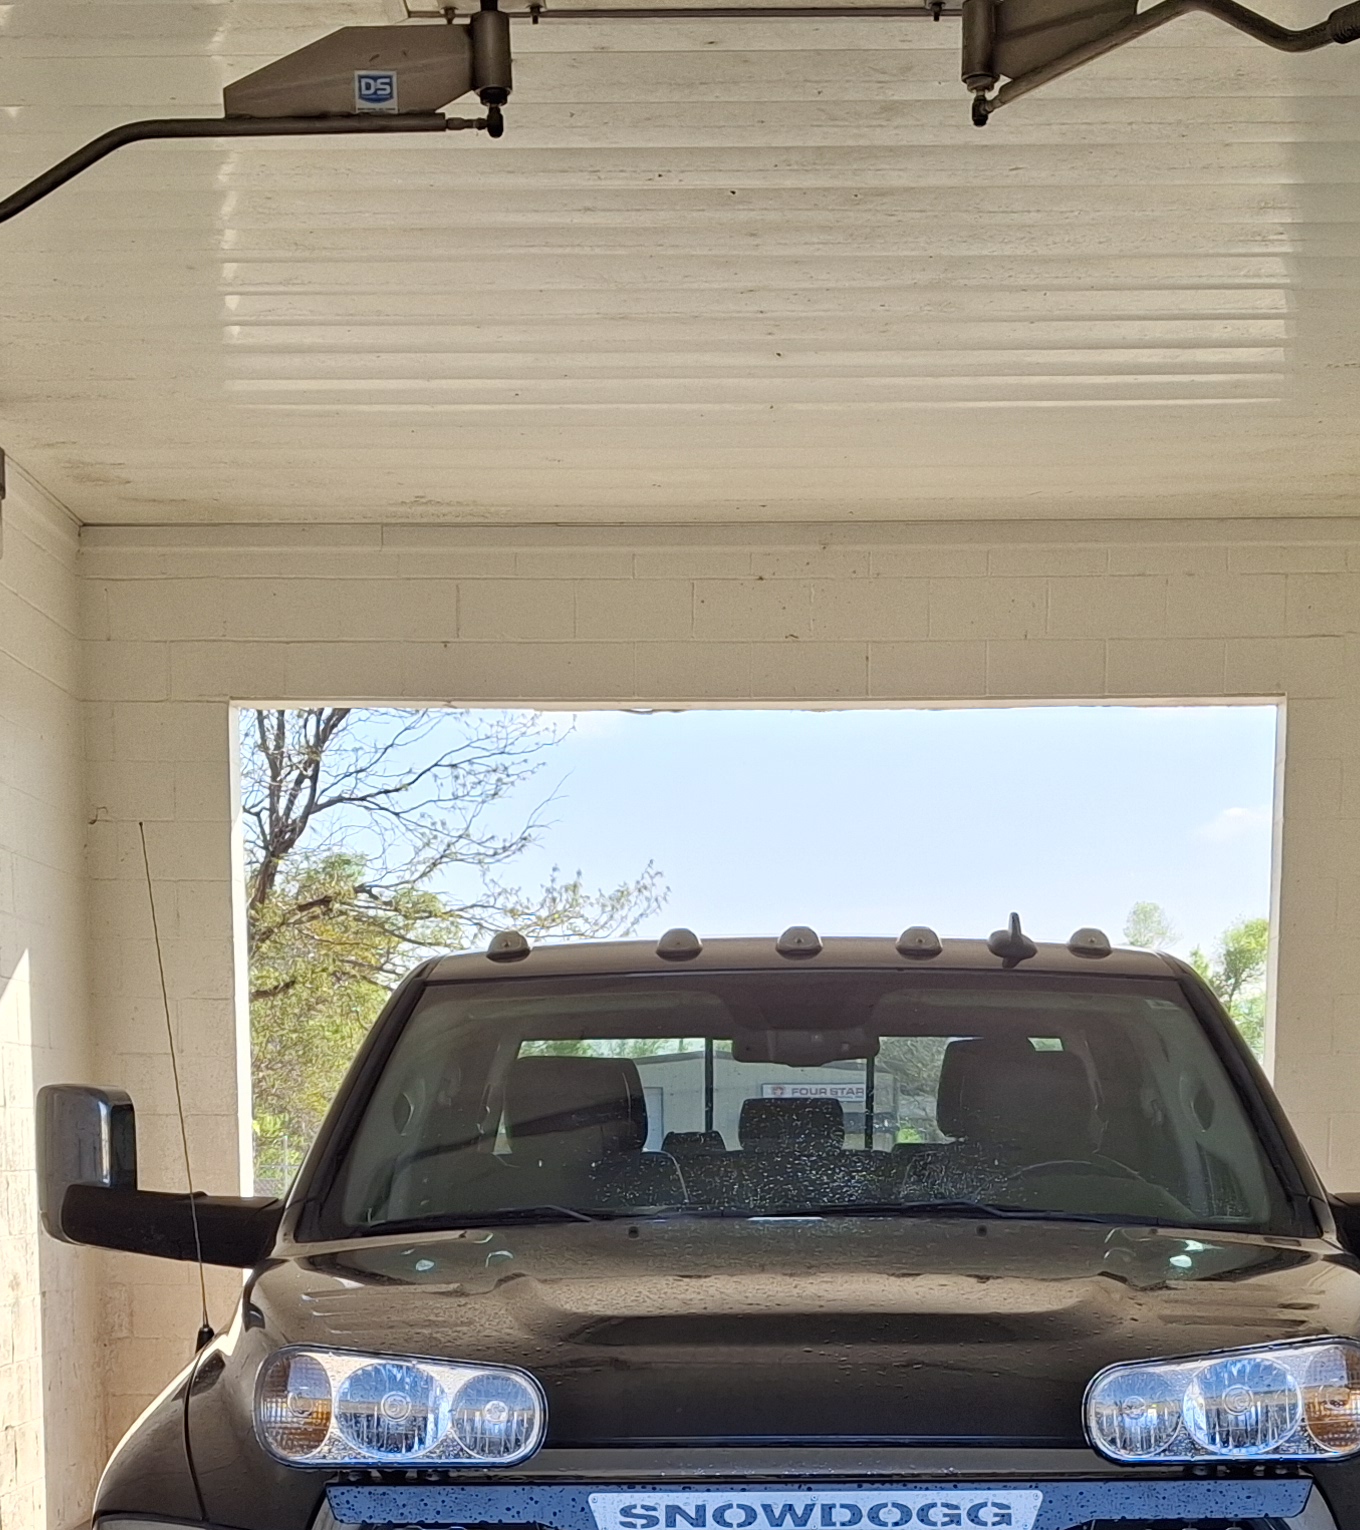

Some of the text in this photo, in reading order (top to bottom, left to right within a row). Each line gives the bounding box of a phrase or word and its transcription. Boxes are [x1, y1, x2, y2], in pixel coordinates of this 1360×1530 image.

[360, 77, 391, 95] DS
[791, 1087, 865, 1096] FOUR STAR
[618, 1500, 1013, 1529] SNOWDOGG
